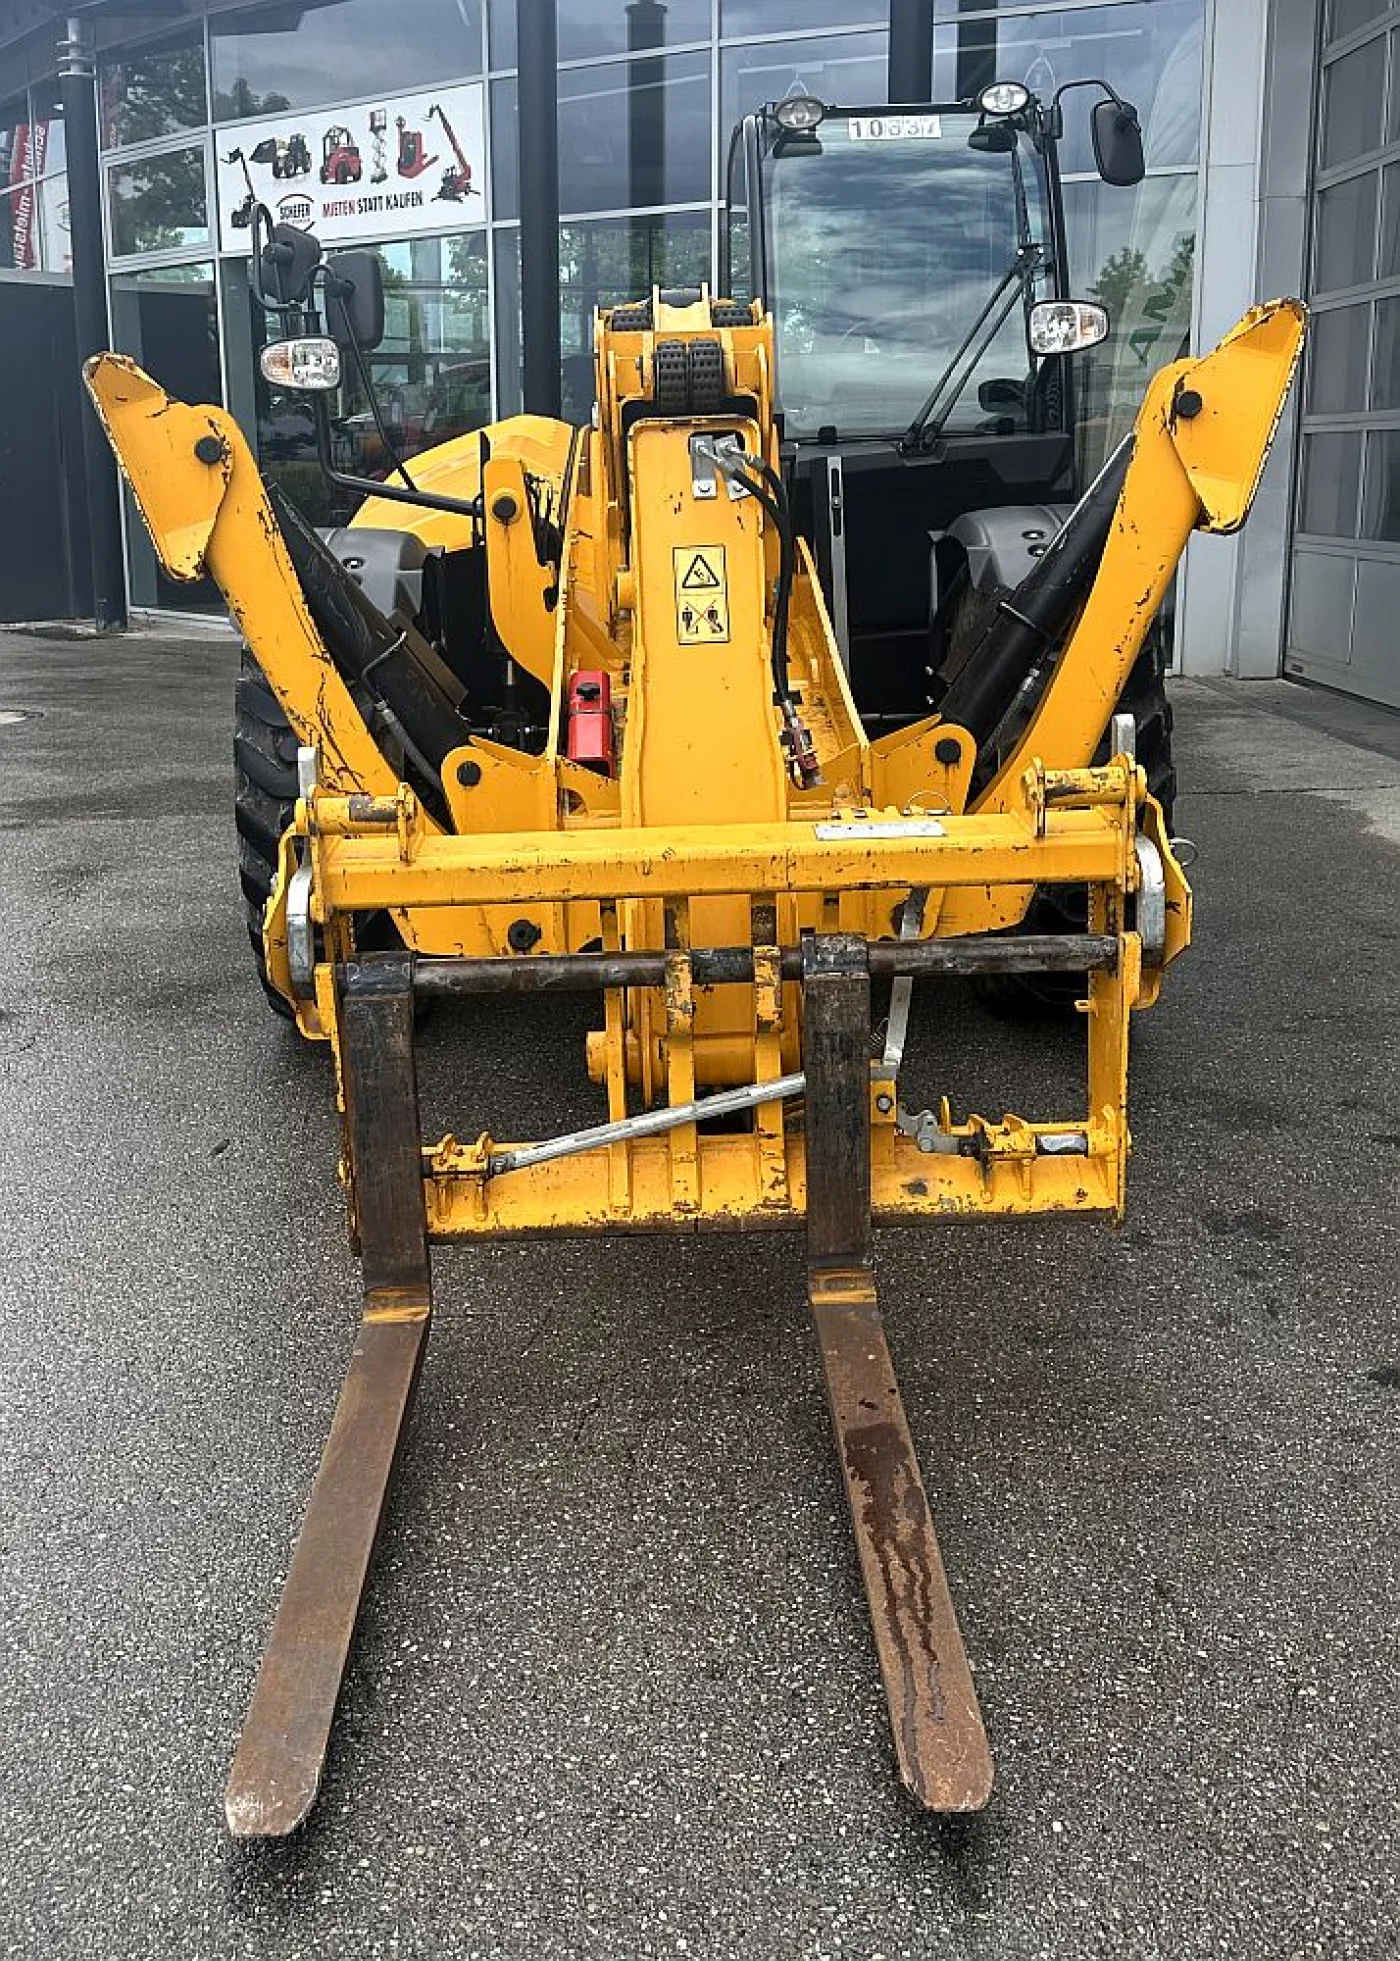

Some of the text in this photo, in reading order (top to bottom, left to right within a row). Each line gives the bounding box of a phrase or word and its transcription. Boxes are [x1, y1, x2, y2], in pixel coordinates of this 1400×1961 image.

[322, 190, 424, 219] MIETEN STATT KAUFEN
